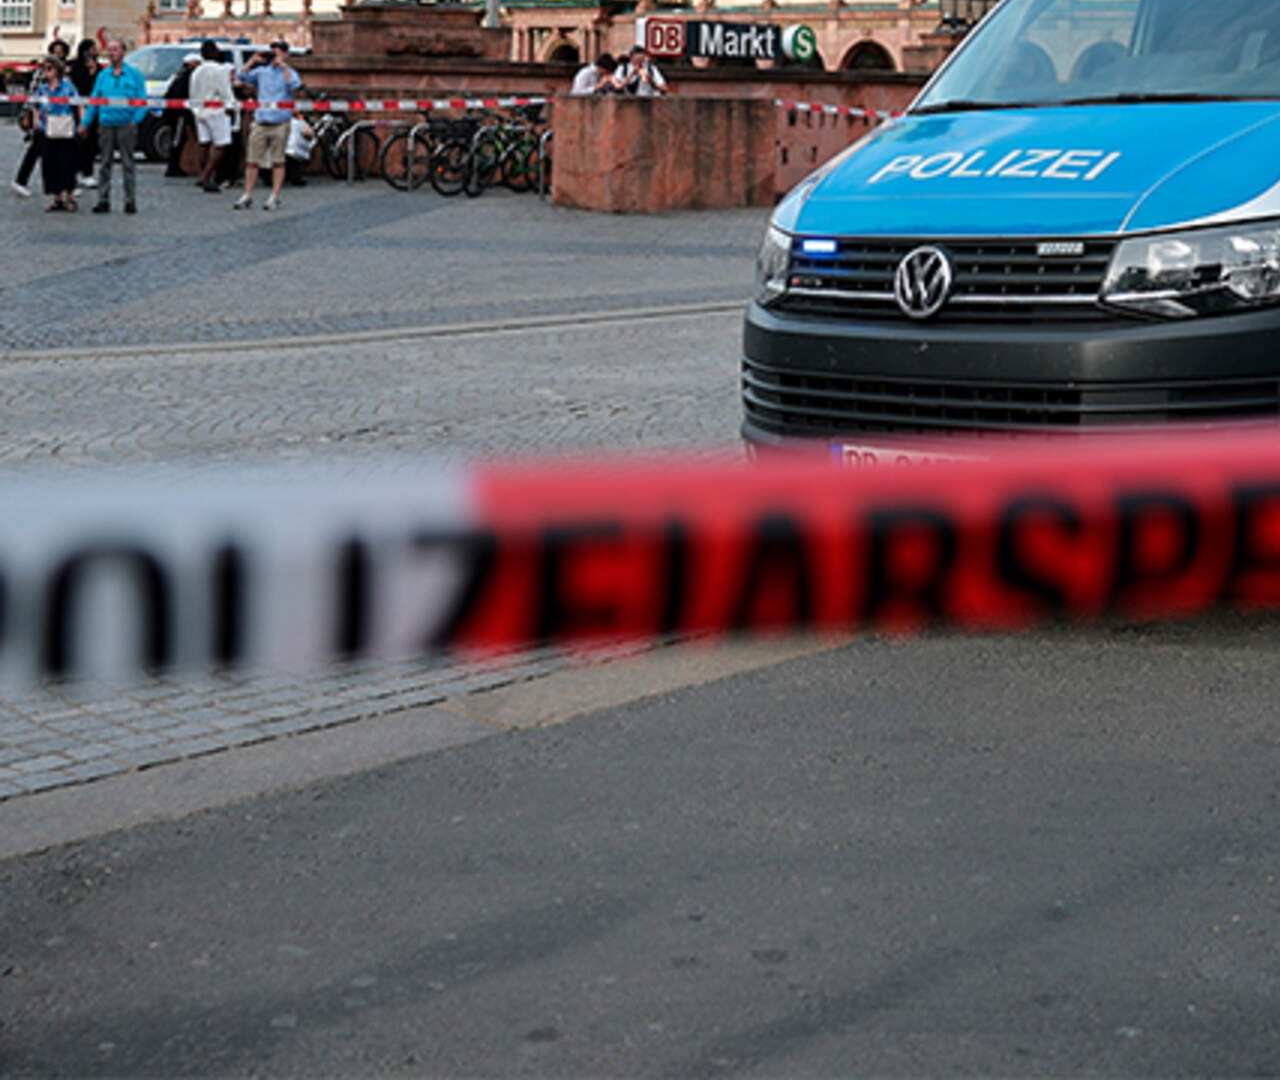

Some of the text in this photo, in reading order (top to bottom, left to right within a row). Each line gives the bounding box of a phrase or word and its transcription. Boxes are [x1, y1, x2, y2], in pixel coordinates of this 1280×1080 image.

[651, 22, 813, 58] DB Markt S
[867, 149, 1121, 184] POLIZEI
